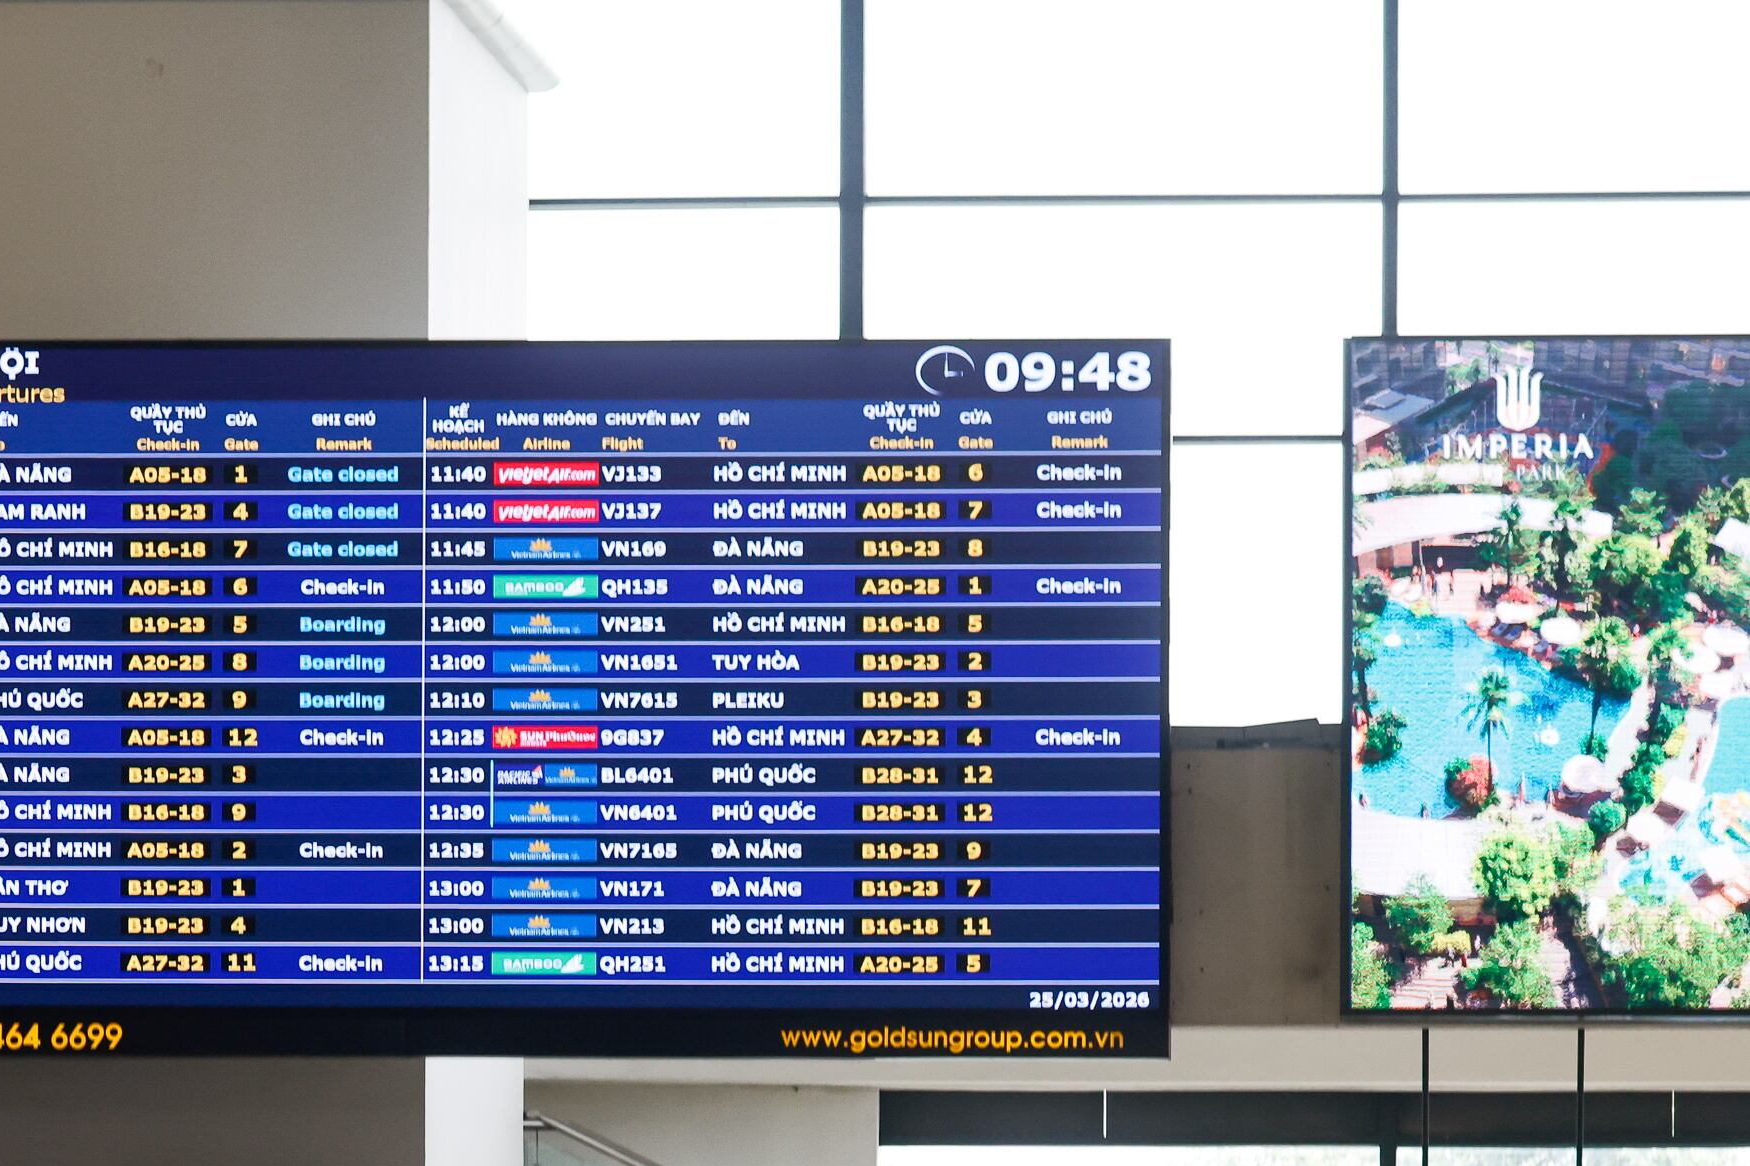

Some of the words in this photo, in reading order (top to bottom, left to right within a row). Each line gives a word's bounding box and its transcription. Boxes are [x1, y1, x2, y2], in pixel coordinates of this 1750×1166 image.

[983, 352, 1152, 392] 09:48
[311, 414, 341, 427] GHI
[136, 437, 200, 452] Check-in
[224, 438, 259, 452] Gate
[316, 437, 373, 452] Remark
[1442, 432, 1594, 460] IMPERIA
[431, 465, 487, 483] 11:40
[601, 465, 662, 483] VJ133
[713, 461, 744, 483] HỒ
[747, 460, 786, 483] CHÍ
[790, 464, 847, 482] MINH
[862, 464, 941, 482] A05-18
[968, 463, 984, 482] 6
[1036, 463, 1122, 481] Check-in
[30, 503, 86, 521] RANH
[130, 503, 206, 521] B19-23
[232, 502, 249, 521] 4
[287, 503, 333, 520] Gate
[337, 502, 399, 520] closed
[15, 574, 53, 596] CHÍ
[58, 579, 114, 596] MINH
[128, 579, 206, 596] A05-18
[233, 577, 248, 596] 6
[300, 578, 385, 596] Check-in
[15, 649, 53, 671] CHÍ
[57, 654, 113, 671] MINH
[128, 654, 205, 671] A20-25
[232, 652, 248, 671] 8
[299, 653, 386, 674] Boarding
[430, 654, 486, 671] 12:00
[600, 654, 678, 671] VN1651
[711, 654, 752, 671] TUY
[756, 649, 800, 671] HÒA
[862, 654, 940, 671] B19-23
[968, 652, 983, 671] 2
[26, 687, 84, 712] QUỐC
[127, 691, 206, 709] A27-32
[231, 690, 247, 709] 9
[299, 691, 385, 712] Boarding
[429, 691, 486, 709] 12:10
[600, 691, 678, 709] VN7615
[712, 691, 785, 709] PLEIKU
[862, 691, 940, 709] B19-23
[967, 690, 982, 709] 3
[429, 728, 485, 746] 12:25
[600, 728, 665, 747] 9G837
[712, 725, 742, 747] HỒ
[746, 725, 784, 747] CHÍ
[789, 728, 846, 747] MINH
[861, 729, 940, 746] A27-32
[966, 727, 983, 747] 4
[1035, 727, 1121, 746] Check-in
[429, 766, 485, 784] 12:30
[600, 766, 674, 784] BL6401
[711, 762, 754, 784] PHÚ
[758, 762, 816, 787] QUỐC
[862, 767, 939, 784] B28-31
[964, 765, 993, 784] 12
[14, 837, 51, 858] CHÍ
[56, 841, 112, 858] MINH
[127, 842, 205, 859] A05-18
[232, 841, 247, 860] 2
[299, 841, 384, 859] Check-in
[1029, 990, 1150, 1009] 25/03/2026
[51, 1022, 123, 1050] 6699
[781, 1025, 1124, 1053] www.goldsungroup.com.vn
